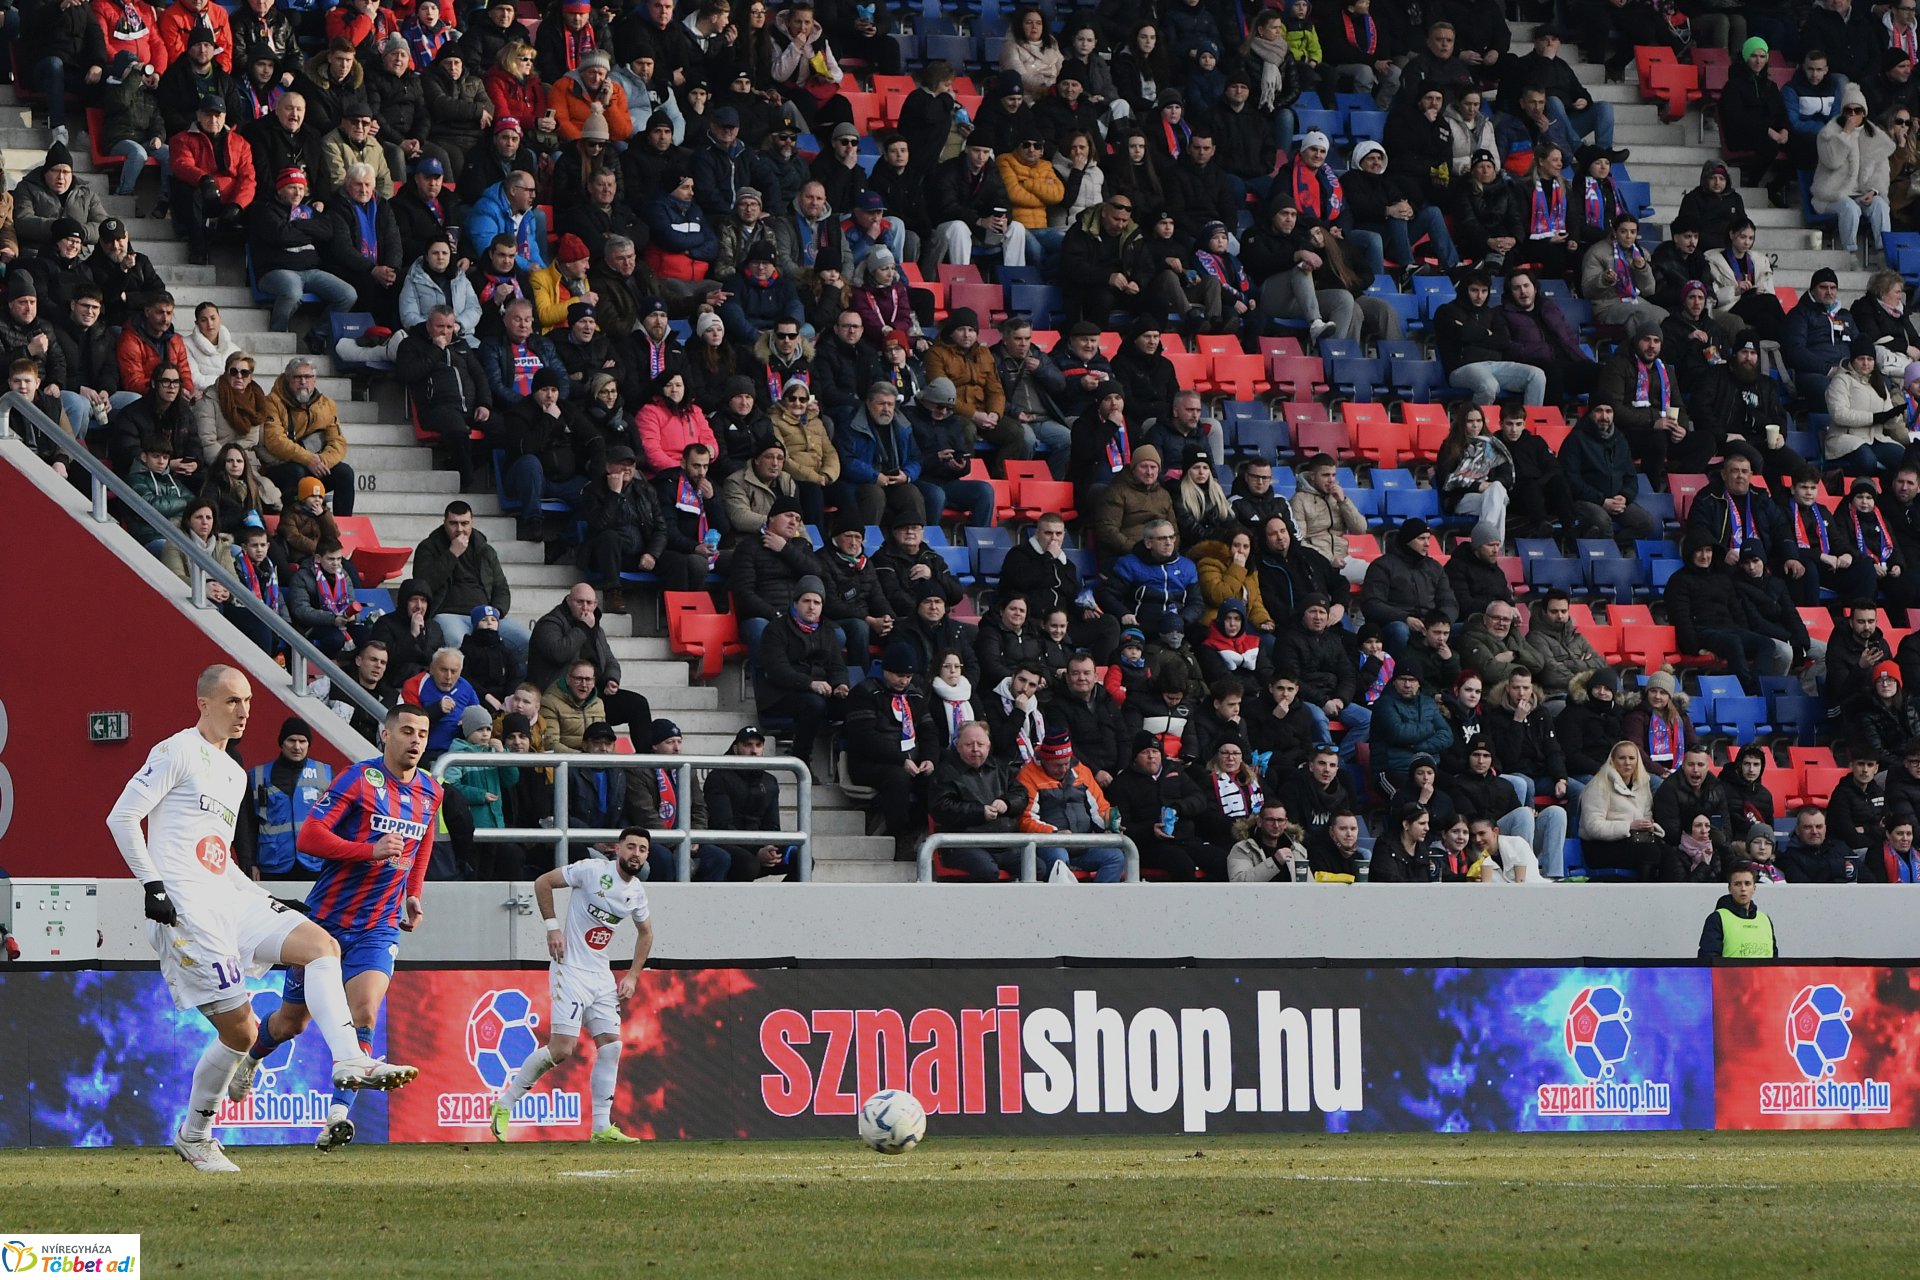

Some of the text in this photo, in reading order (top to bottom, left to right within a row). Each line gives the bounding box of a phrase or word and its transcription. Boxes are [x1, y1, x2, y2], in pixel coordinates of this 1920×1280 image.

[358, 475, 376, 490] 08
[760, 985, 1363, 1133] szparishop.hu
[1540, 1081, 1668, 1113] szparishop.hu
[1761, 1080, 1888, 1111] szparishop.hu
